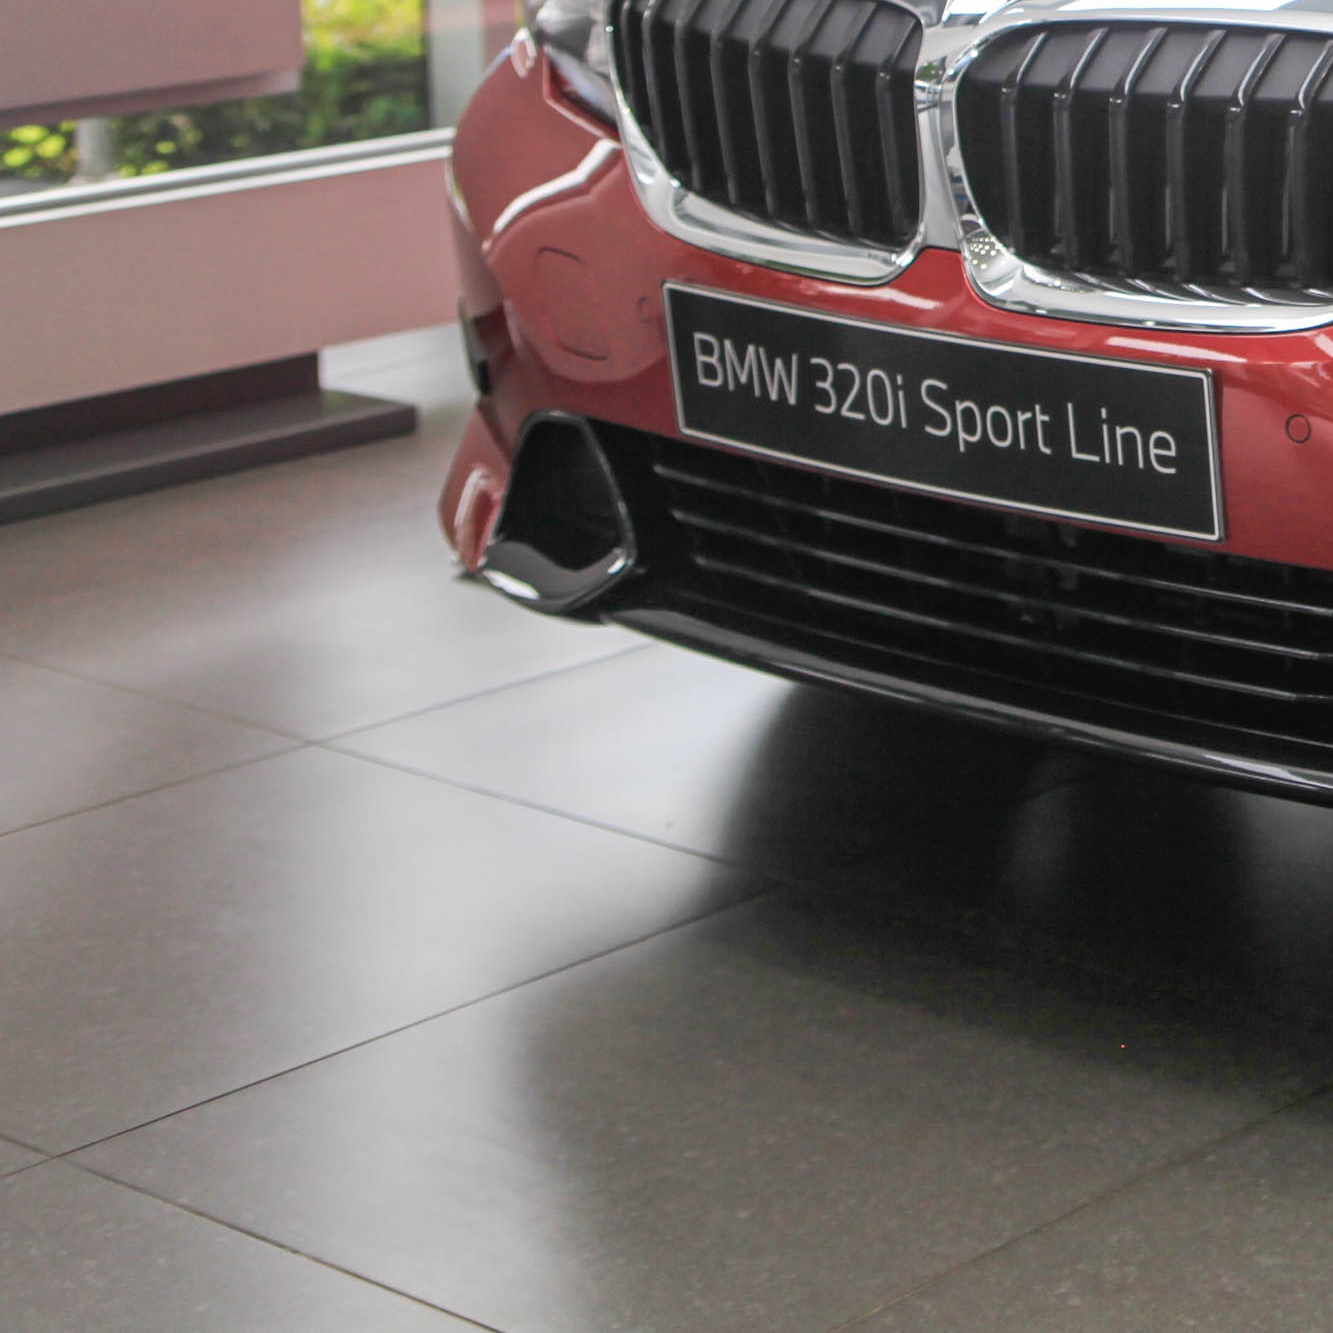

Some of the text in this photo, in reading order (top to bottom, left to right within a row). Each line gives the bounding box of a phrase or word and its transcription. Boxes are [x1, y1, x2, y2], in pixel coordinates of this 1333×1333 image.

[693, 331, 1177, 474] BMW 320i Sport Line
